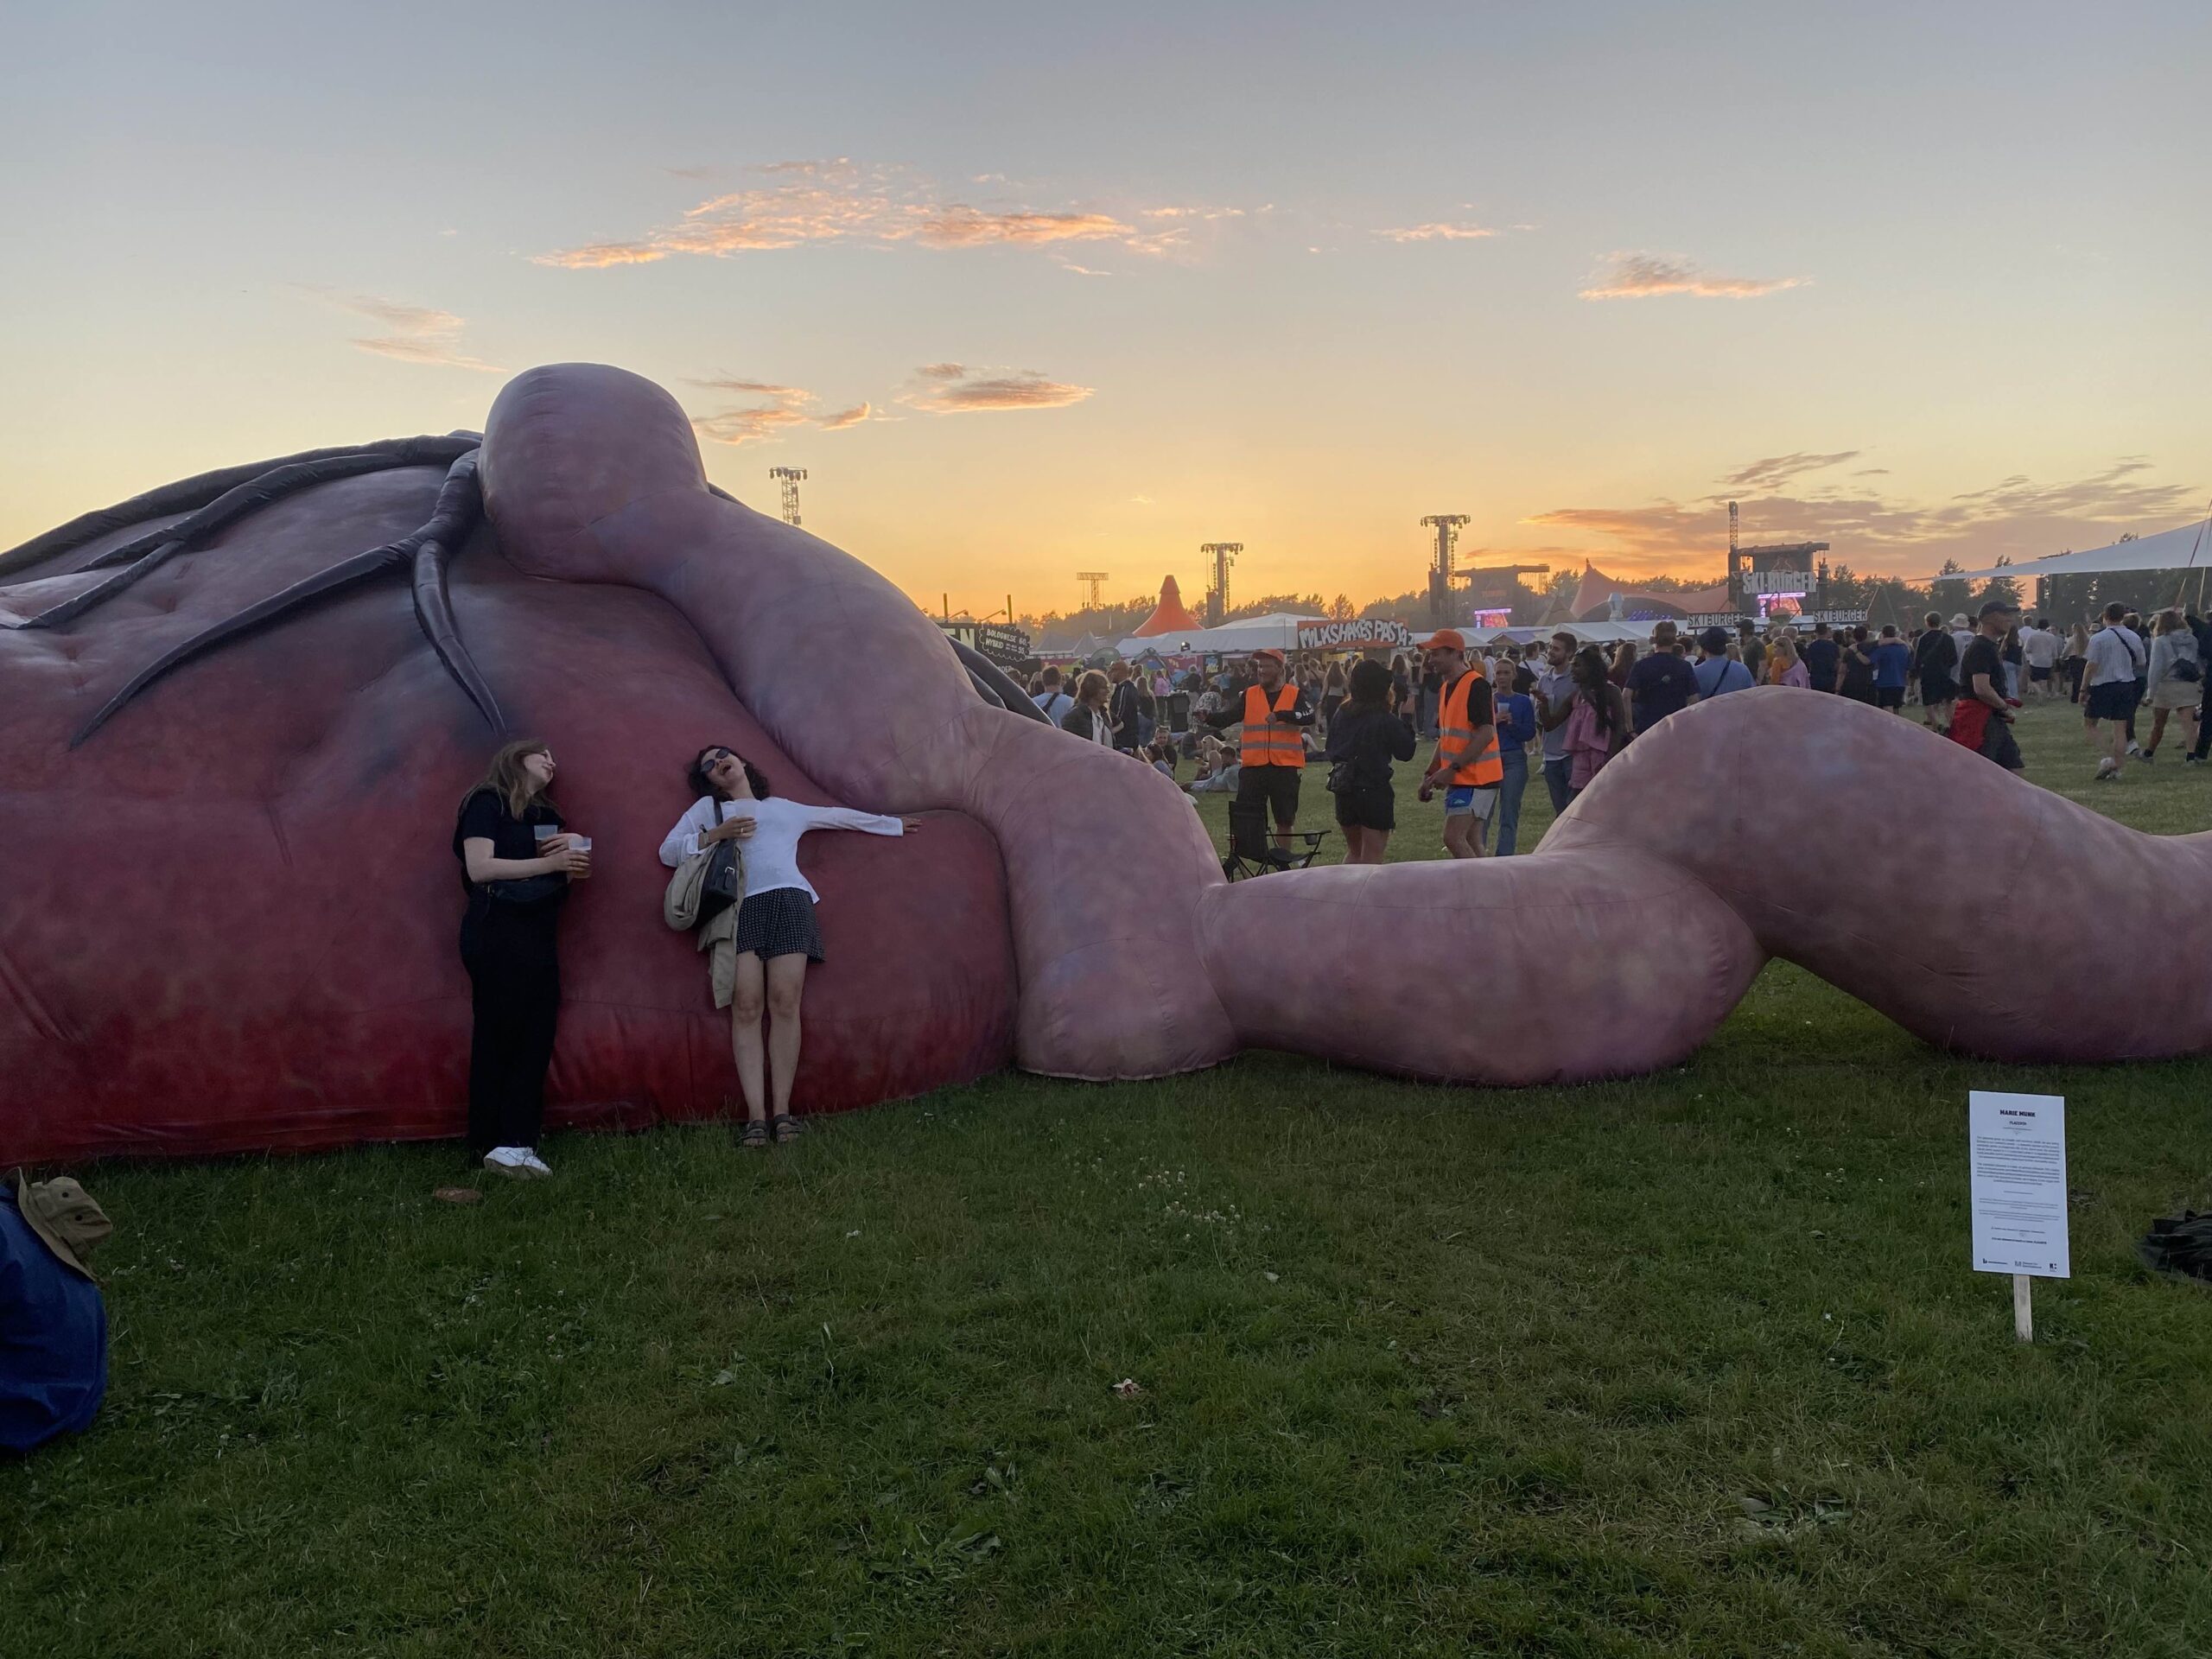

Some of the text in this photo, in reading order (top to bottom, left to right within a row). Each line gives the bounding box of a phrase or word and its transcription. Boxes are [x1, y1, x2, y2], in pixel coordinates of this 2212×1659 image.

[986, 628, 1017, 643] BOLOGNESE
[1299, 620, 1408, 648] MILKSHAKES PASTA
[985, 638, 1004, 649] HYBRID
